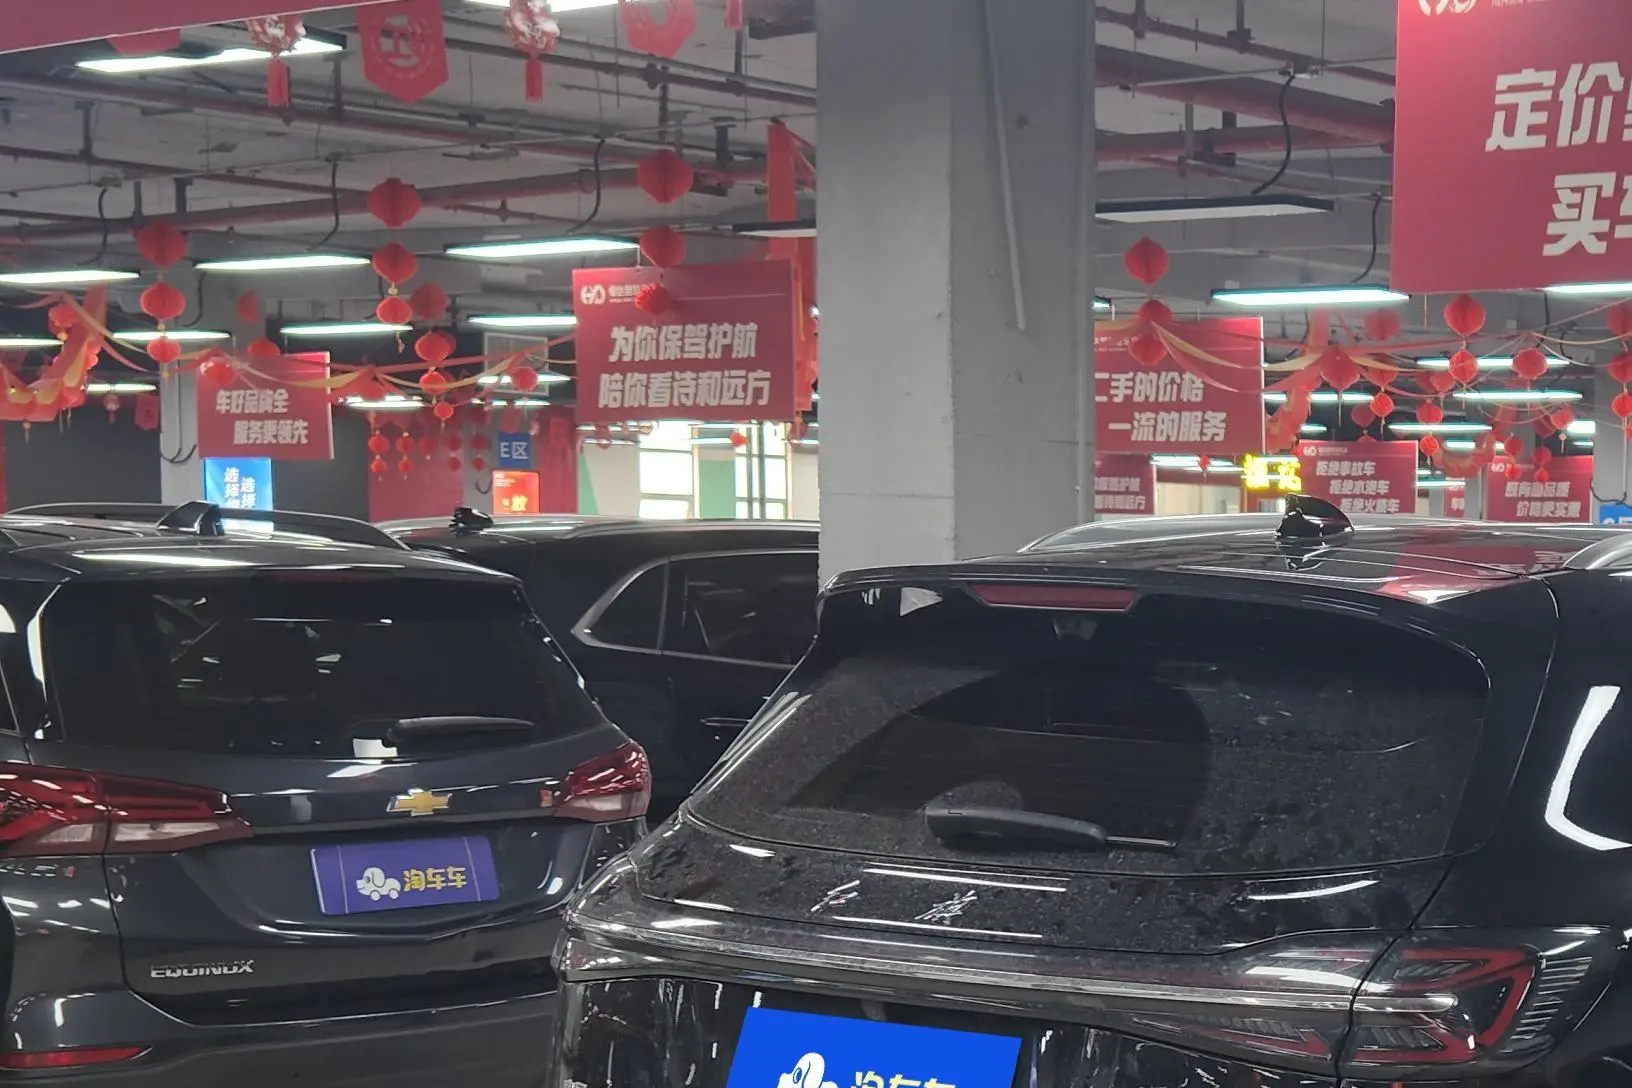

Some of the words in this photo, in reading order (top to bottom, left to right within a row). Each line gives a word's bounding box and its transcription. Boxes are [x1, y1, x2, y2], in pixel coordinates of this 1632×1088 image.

[608, 322, 758, 362] 为你保驾护航
[598, 369, 771, 408] 陪你看诗和远方
[1095, 371, 1204, 402] 二手的价格
[1108, 411, 1227, 442] 一流的服务
[501, 441, 528, 459] E区
[403, 866, 467, 892] 淘车车
